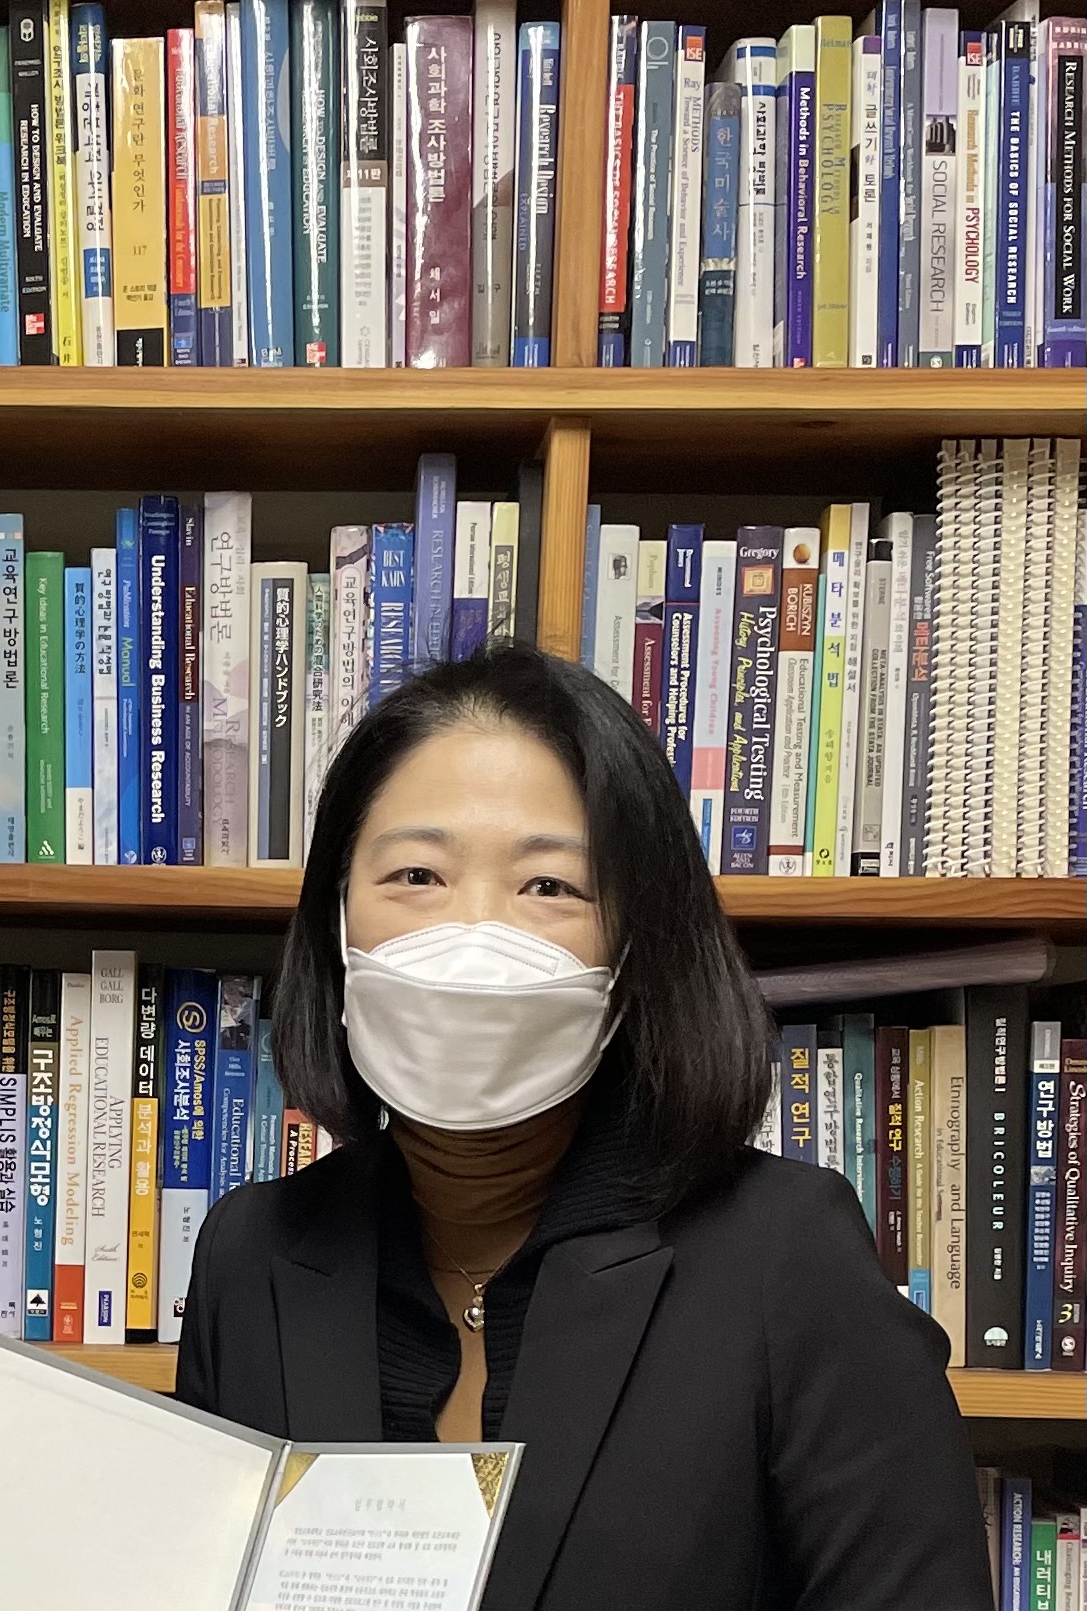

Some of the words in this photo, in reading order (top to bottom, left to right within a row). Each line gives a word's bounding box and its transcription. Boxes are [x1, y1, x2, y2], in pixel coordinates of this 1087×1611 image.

[132, 69, 146, 97] 문화
[427, 46, 447, 114] 사회과학
[1065, 62, 1078, 126] RESEARCH
[132, 101, 146, 147] 연구란
[799, 87, 811, 142] Methods
[427, 119, 446, 203] 조사방법론
[798, 145, 807, 156] in
[1064, 131, 1077, 193] METHODS
[132, 155, 146, 212] 무엇인가
[797, 159, 810, 222] Behavioral
[931, 160, 948, 218] SOCIAL
[1064, 198, 1075, 221] FOR
[795, 225, 808, 280] Research
[929, 221, 946, 313] RESEARCH
[1063, 226, 1076, 270] SOCIAL
[1062, 274, 1075, 313] WORK
[739, 547, 780, 560] Gregory
[2, 549, 20, 689] 교육연구방법론
[149, 554, 167, 670] Understanding
[786, 587, 798, 632] BORICH
[800, 583, 812, 637] KUBISZYN
[748, 606, 775, 728] Psychological
[800, 658, 810, 714] Educational
[150, 675, 166, 746] Business
[797, 716, 808, 751] Testing
[150, 750, 166, 824] Research
[745, 732, 770, 801] Testing
[795, 752, 804, 770] and
[792, 772, 804, 838] Measurement
[140, 987, 158, 1039] 다변량
[66, 1016, 83, 1078] Applied
[138, 1045, 156, 1096] 데이터
[790, 1047, 810, 1094] 질적
[93, 1036, 109, 1144] EDUCATIONAL
[173, 1038, 192, 1121] 사회조사분석
[1037, 1080, 1055, 1118] 연구
[0, 1077, 17, 1144] SIMPLIS
[29, 1049, 53, 1207] 구조방정식모형
[66, 1083, 83, 1166] Regression
[108, 1095, 124, 1169] APPLYING
[136, 1102, 152, 1154] 분석과
[790, 1102, 812, 1149] 연구
[1036, 1122, 1054, 1158] 방법
[1064, 1081, 1085, 1149] Strategies
[91, 1145, 108, 1218] RESEARCH
[992, 1112, 1006, 1231] BRICOLEUR
[1067, 1151, 1078, 1167] of
[60, 1171, 80, 1246] Modeling
[949, 1183, 961, 1212] and
[1064, 1168, 1080, 1244] Qualitative
[946, 1218, 963, 1290] Language
[1059, 1246, 1077, 1293] Inquiry
